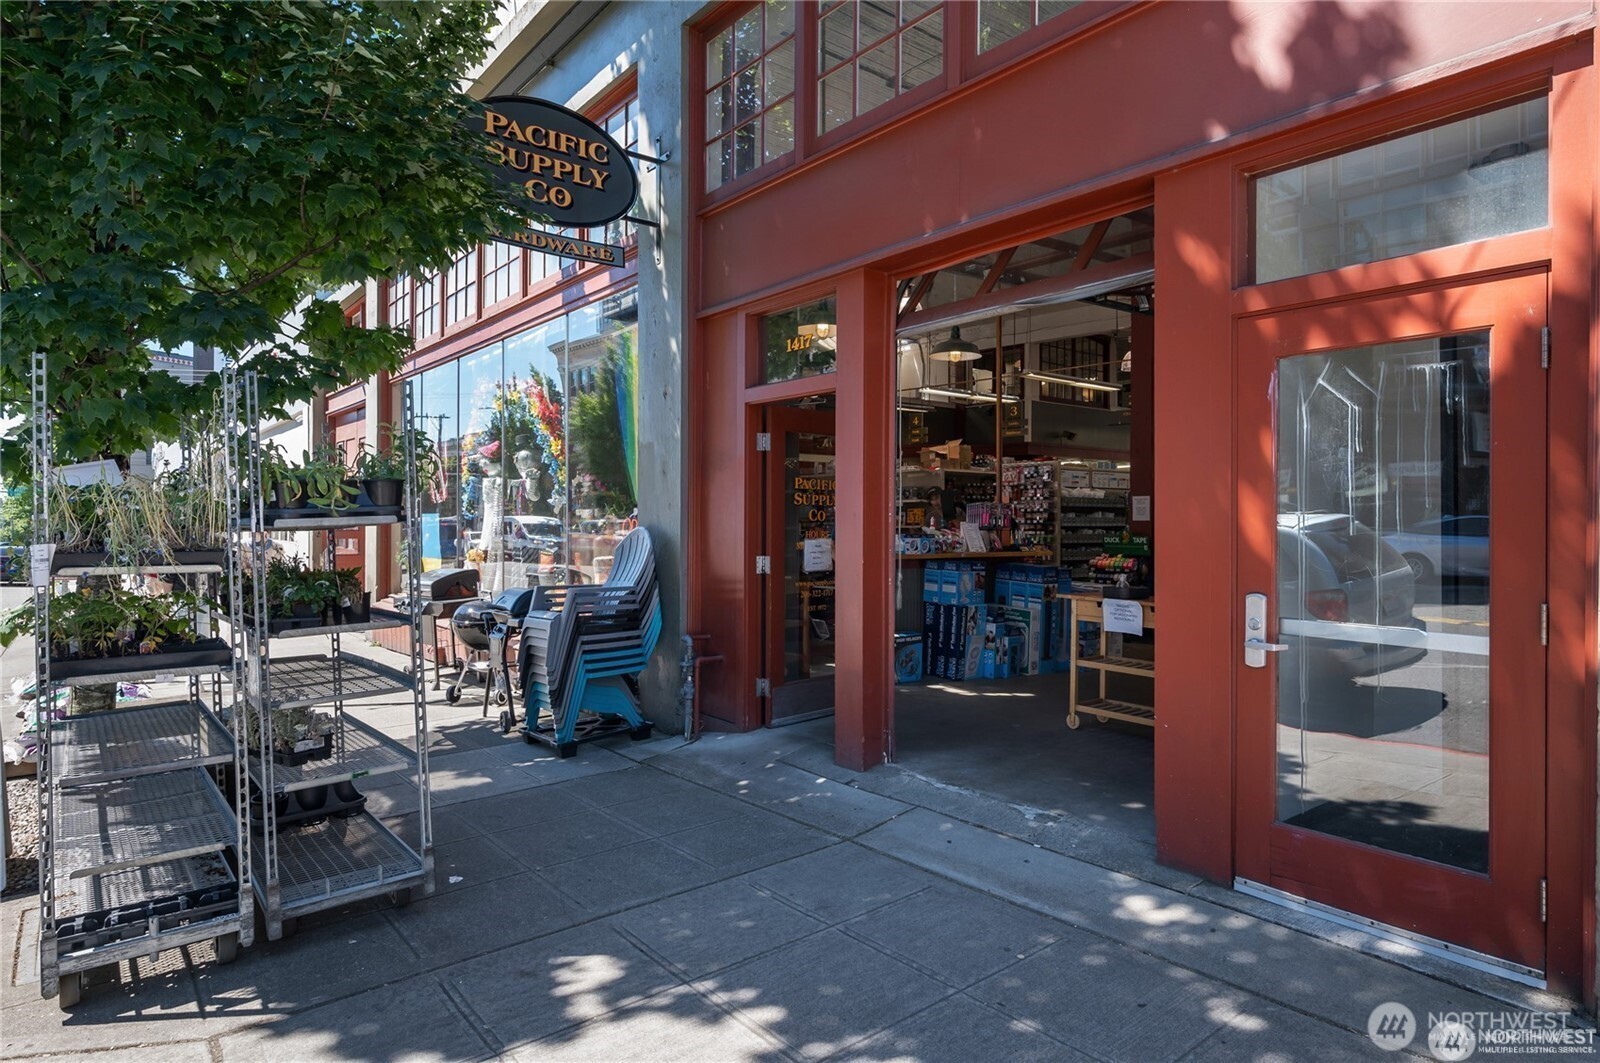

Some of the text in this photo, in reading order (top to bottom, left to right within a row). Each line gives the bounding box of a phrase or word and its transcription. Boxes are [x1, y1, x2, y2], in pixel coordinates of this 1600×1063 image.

[484, 110, 609, 164] PACIFIC
[484, 140, 609, 190] SUPPLY
[523, 178, 573, 208] CO
[491, 229, 615, 262] RDWARE
[786, 333, 813, 352] 1417
[912, 416, 920, 425] 4
[1010, 406, 1018, 416] 3
[794, 492, 836, 506] SUPPL
[808, 509, 826, 522] CO
